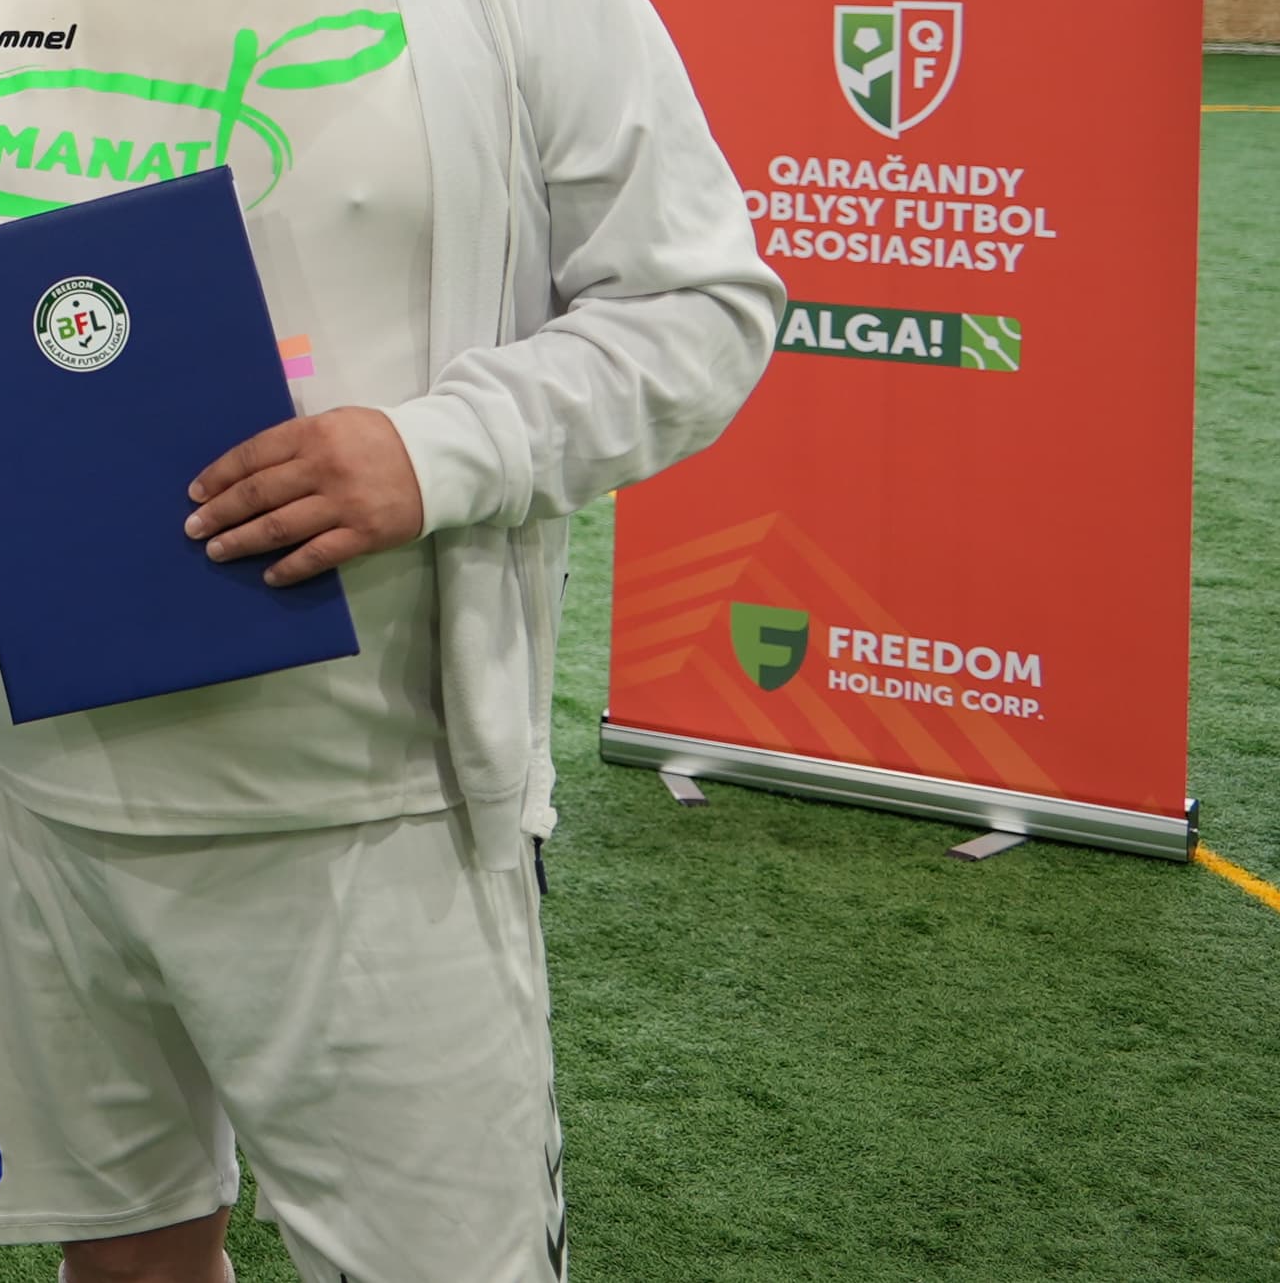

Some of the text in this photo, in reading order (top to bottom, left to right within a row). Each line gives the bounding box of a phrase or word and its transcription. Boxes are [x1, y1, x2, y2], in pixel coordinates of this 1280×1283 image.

[907, 20, 944, 52] Q
[913, 56, 937, 90] F
[767, 154, 1025, 199] QARAĞANDY
[743, 189, 1057, 239] OBLYSY FUTBOL
[764, 227, 1025, 273] ASOSIASIASY
[51, 281, 94, 298] FREEDOM
[44, 322, 124, 366] BALALAR FUTBOL LIGASY
[56, 310, 107, 339] BFL
[781, 308, 945, 358] ALGA!
[828, 625, 1043, 689] FREEDOM
[828, 669, 1045, 722] HOLDING CORP.
